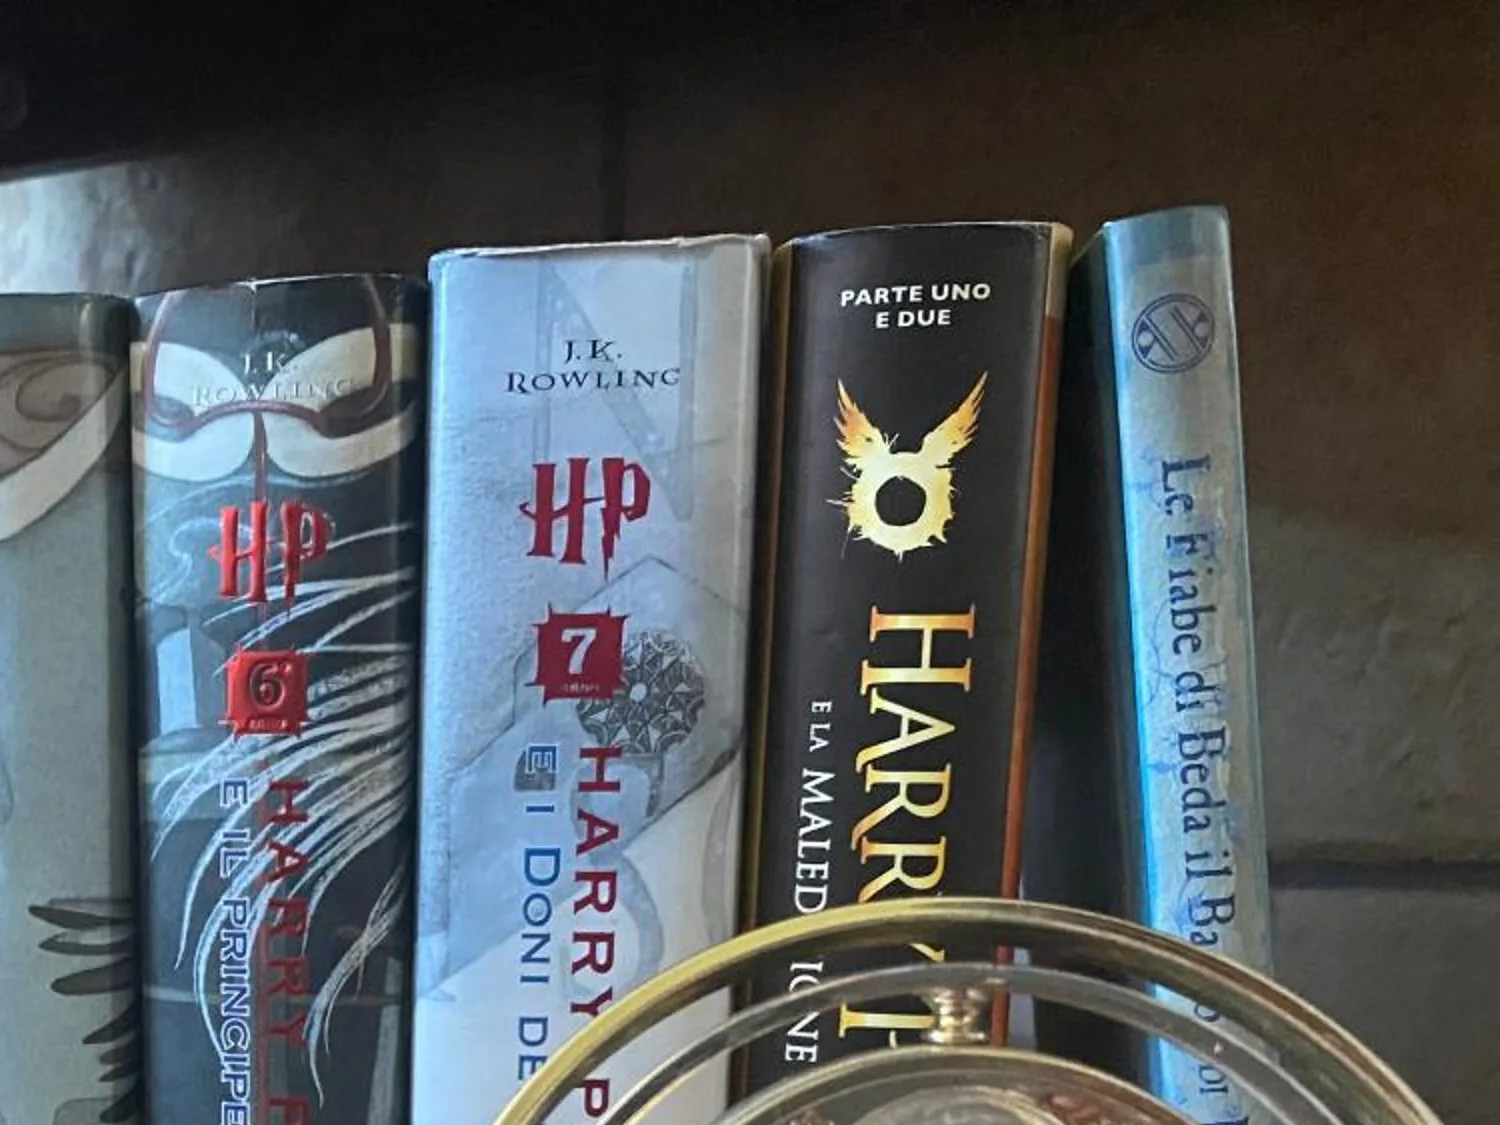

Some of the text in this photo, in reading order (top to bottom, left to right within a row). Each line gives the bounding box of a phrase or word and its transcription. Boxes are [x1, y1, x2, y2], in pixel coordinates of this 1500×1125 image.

[841, 282, 991, 306] PARTE UNO
[875, 309, 951, 329] E DUE
[505, 368, 681, 395] ROWLING
[1160, 455, 1213, 515] Le
[518, 457, 651, 582] HP
[208, 501, 333, 620] HP
[1165, 533, 1217, 655] Fiabe
[561, 628, 597, 675] 7
[811, 700, 833, 715] E
[1175, 671, 1221, 712] di
[809, 719, 832, 753] LA
[524, 745, 557, 774] E
[1177, 726, 1228, 834] Beda
[220, 778, 249, 809] E
[851, 604, 977, 963] HARR
[526, 804, 555, 814] I
[219, 828, 250, 879] IL
[1184, 850, 1233, 880] il
[266, 778, 311, 1049] HARRY
[519, 847, 561, 983] DONI
